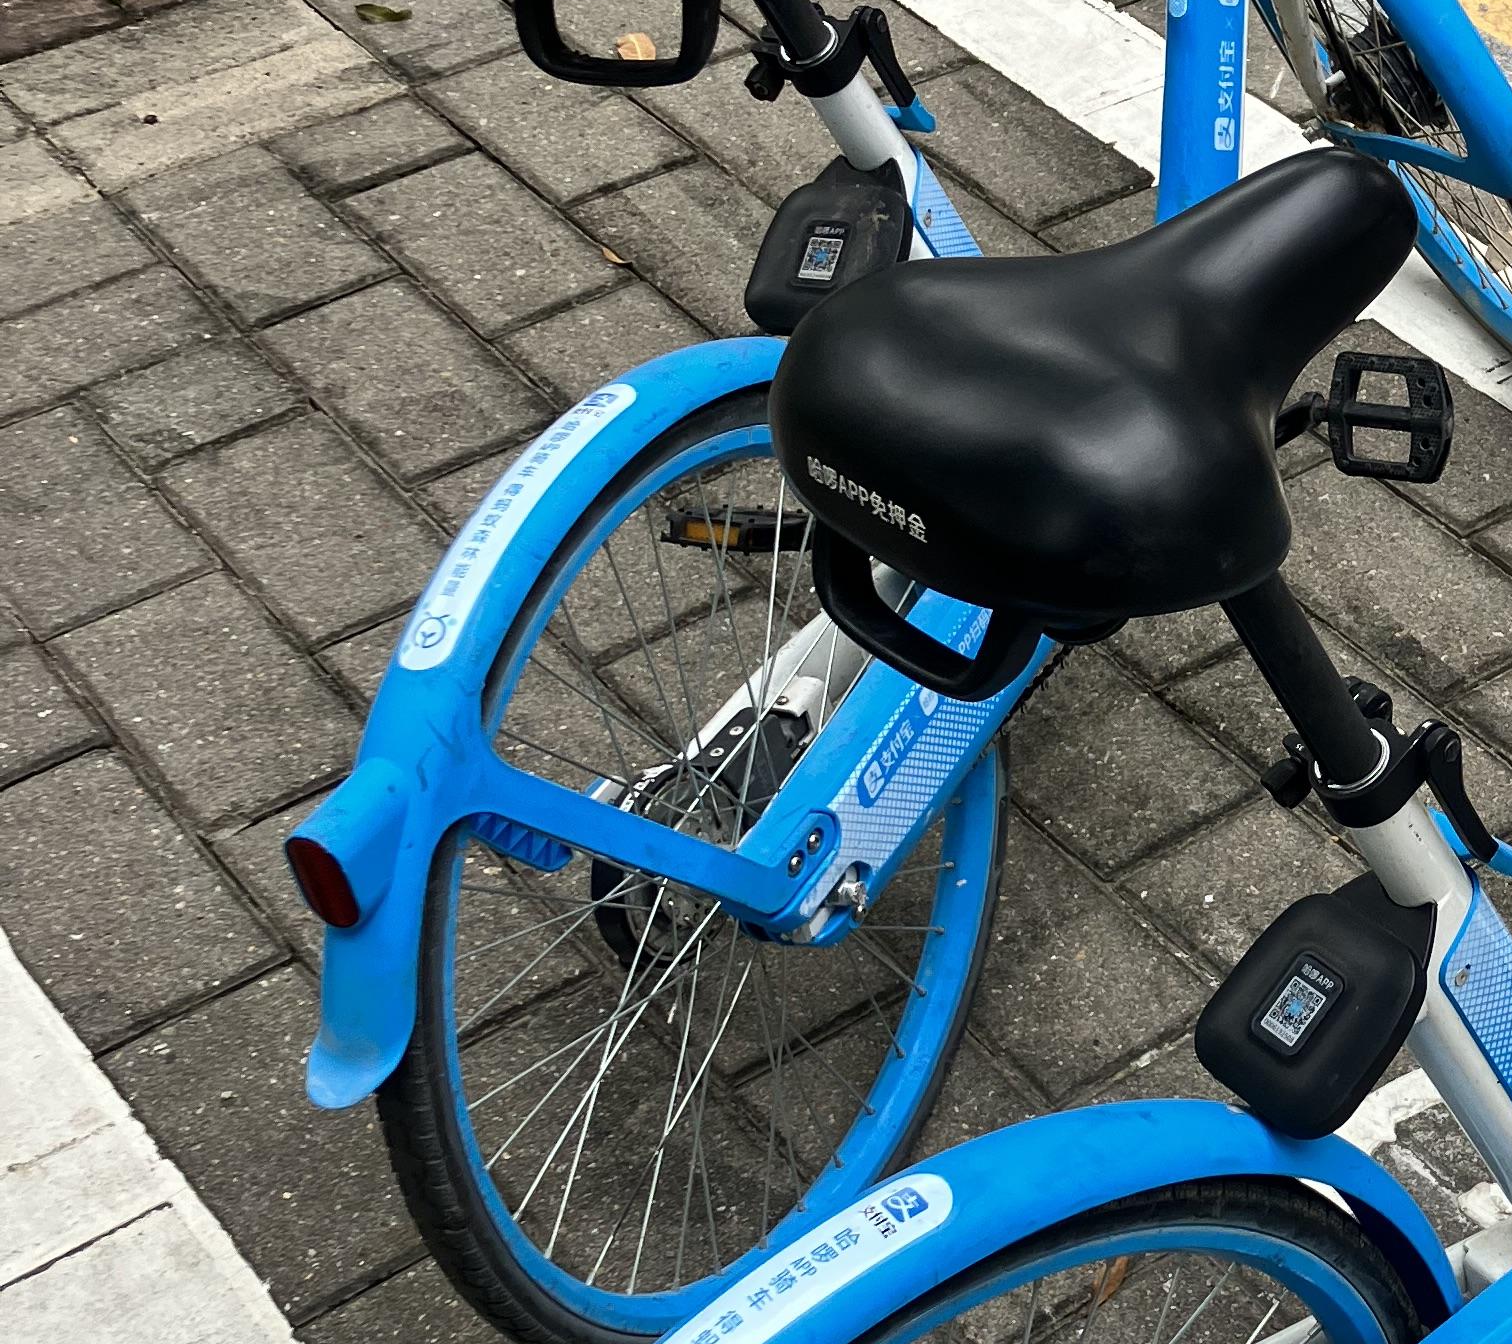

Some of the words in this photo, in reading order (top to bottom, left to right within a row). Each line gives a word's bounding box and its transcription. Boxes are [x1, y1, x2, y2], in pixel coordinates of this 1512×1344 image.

[1218, 40, 1235, 114] 支付宝
[880, 719, 915, 775] 支付宝
[858, 1205, 897, 1240] 支付宝
